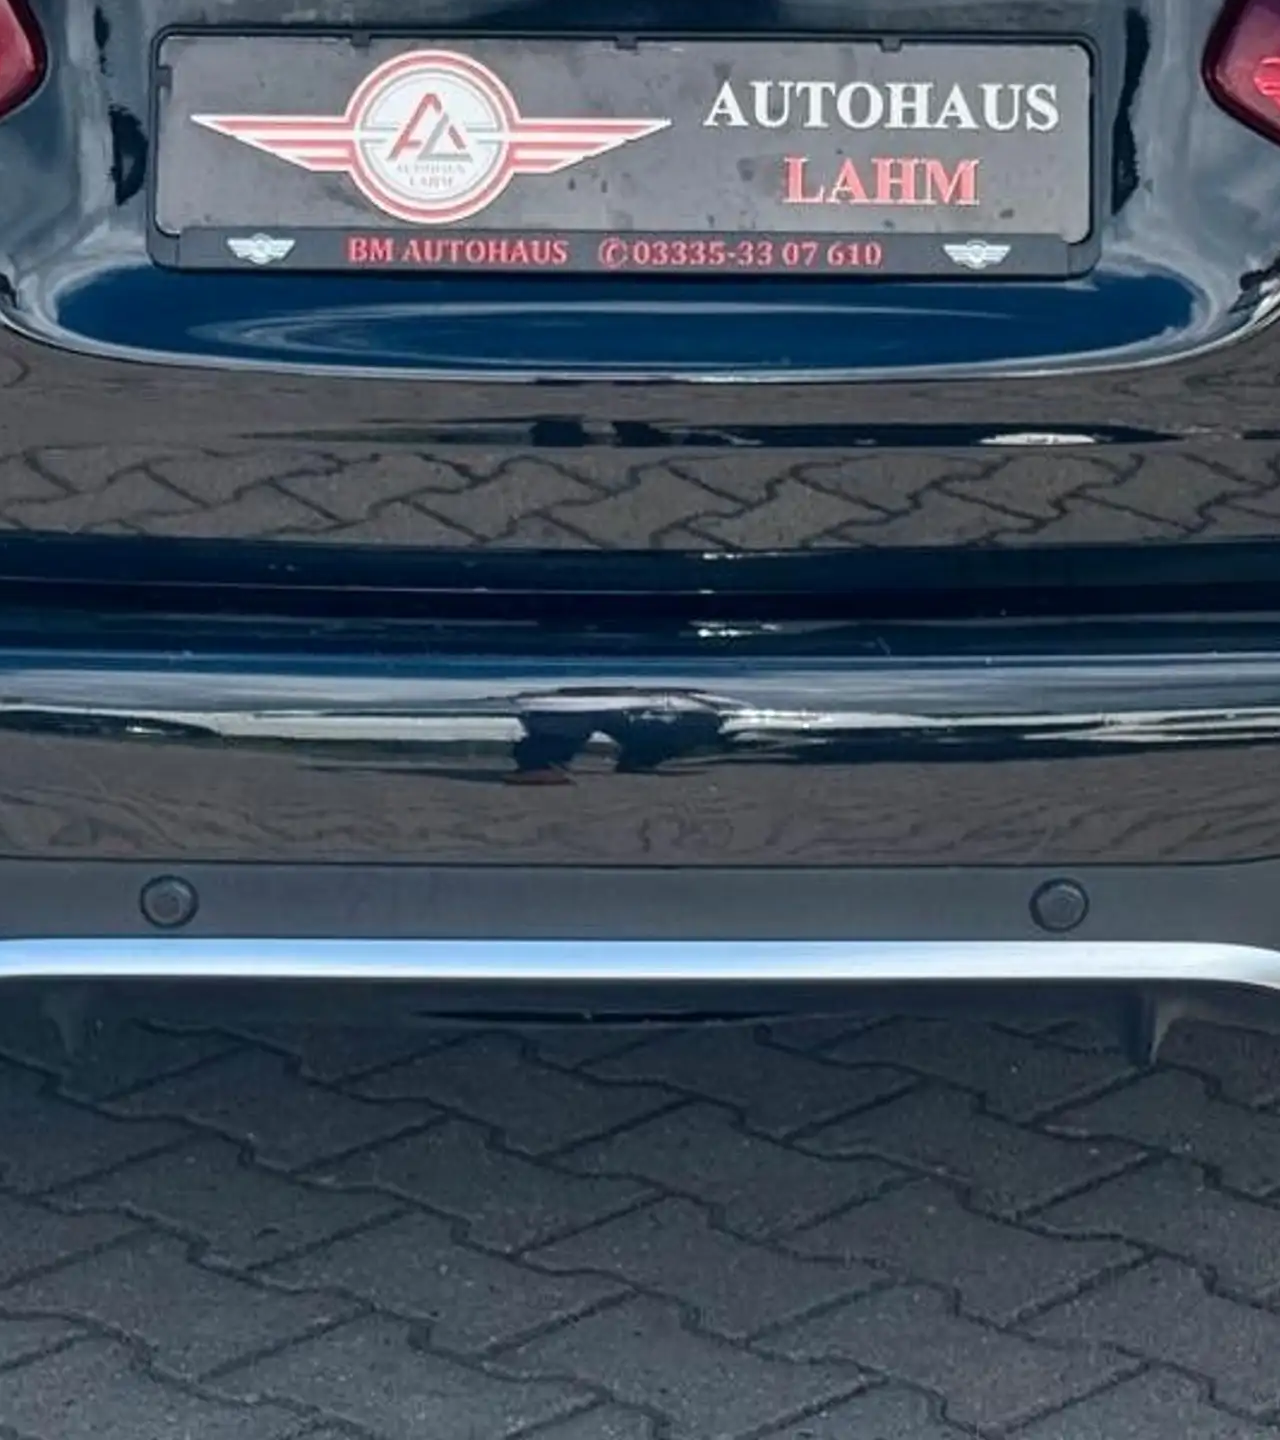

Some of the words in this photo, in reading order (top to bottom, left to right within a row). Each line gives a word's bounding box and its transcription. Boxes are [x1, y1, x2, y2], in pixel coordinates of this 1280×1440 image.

[702, 80, 1060, 132] AUTOHAUS
[782, 156, 981, 206] LAHM
[347, 238, 394, 264] BM
[401, 239, 569, 265] AUTOHAUS
[632, 240, 773, 266] 03335-33
[781, 241, 818, 267] 07
[826, 241, 882, 267] 610
